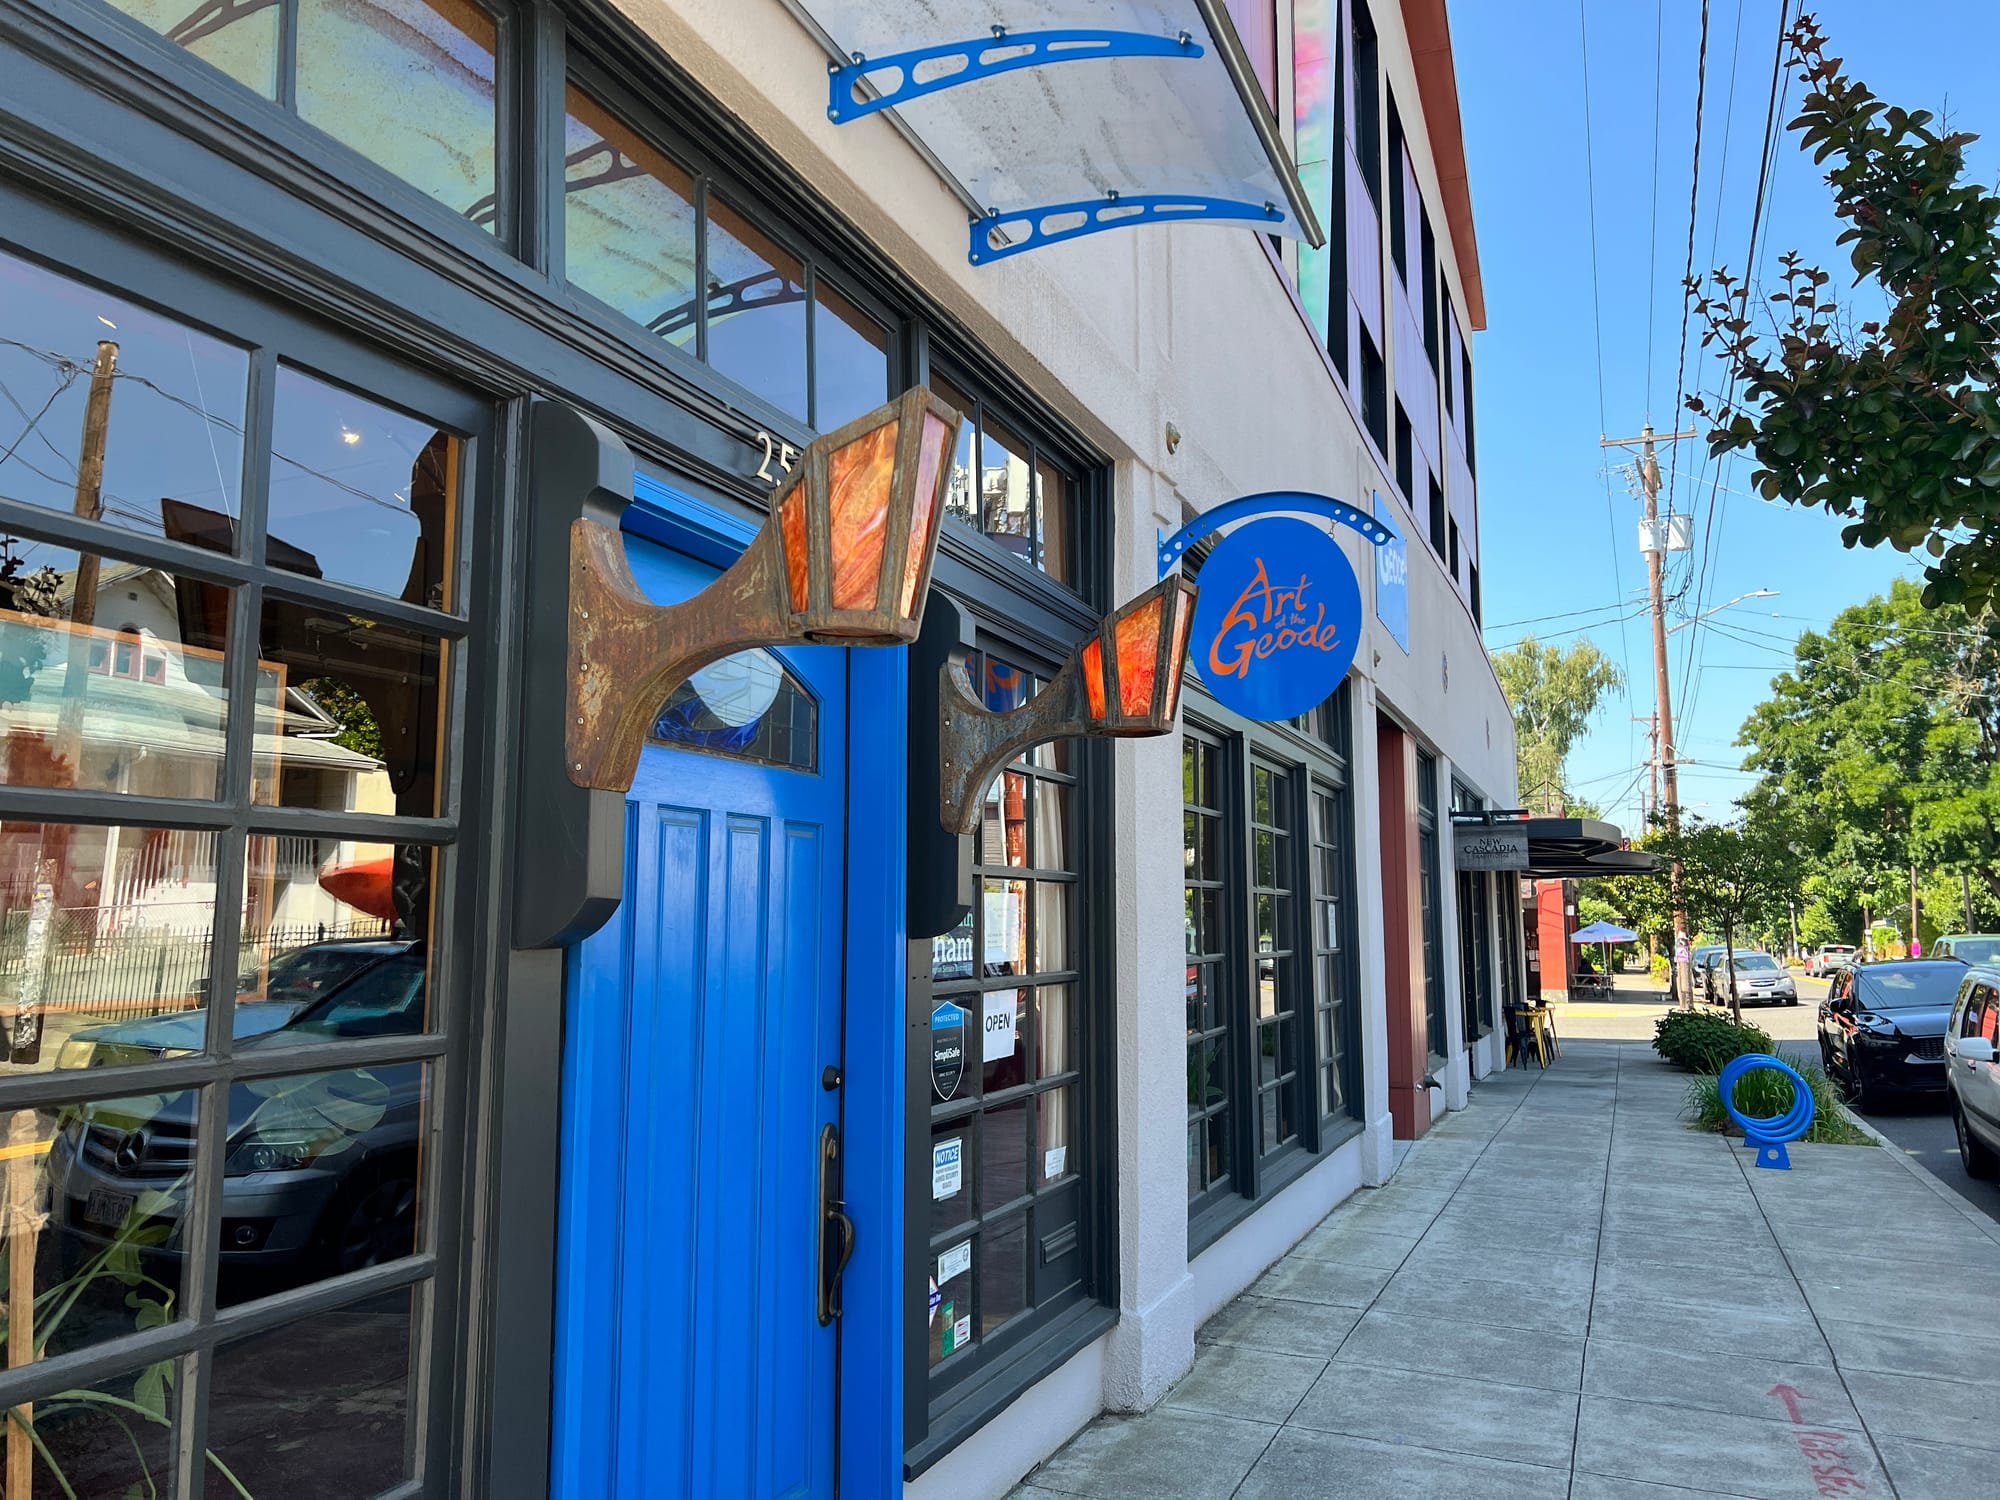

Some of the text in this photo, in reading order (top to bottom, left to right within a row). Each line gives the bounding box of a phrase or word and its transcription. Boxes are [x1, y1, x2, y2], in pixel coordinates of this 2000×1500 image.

[1222, 557, 1312, 626] Art
[1209, 602, 1340, 679] Geode
[1463, 844, 1518, 854] CASCADIA
[1479, 837, 1502, 846] NEW
[985, 1012, 1010, 1032] OPEN
[934, 1047, 960, 1061] SimpliSafe
[935, 1147, 959, 1165] NOTICE
